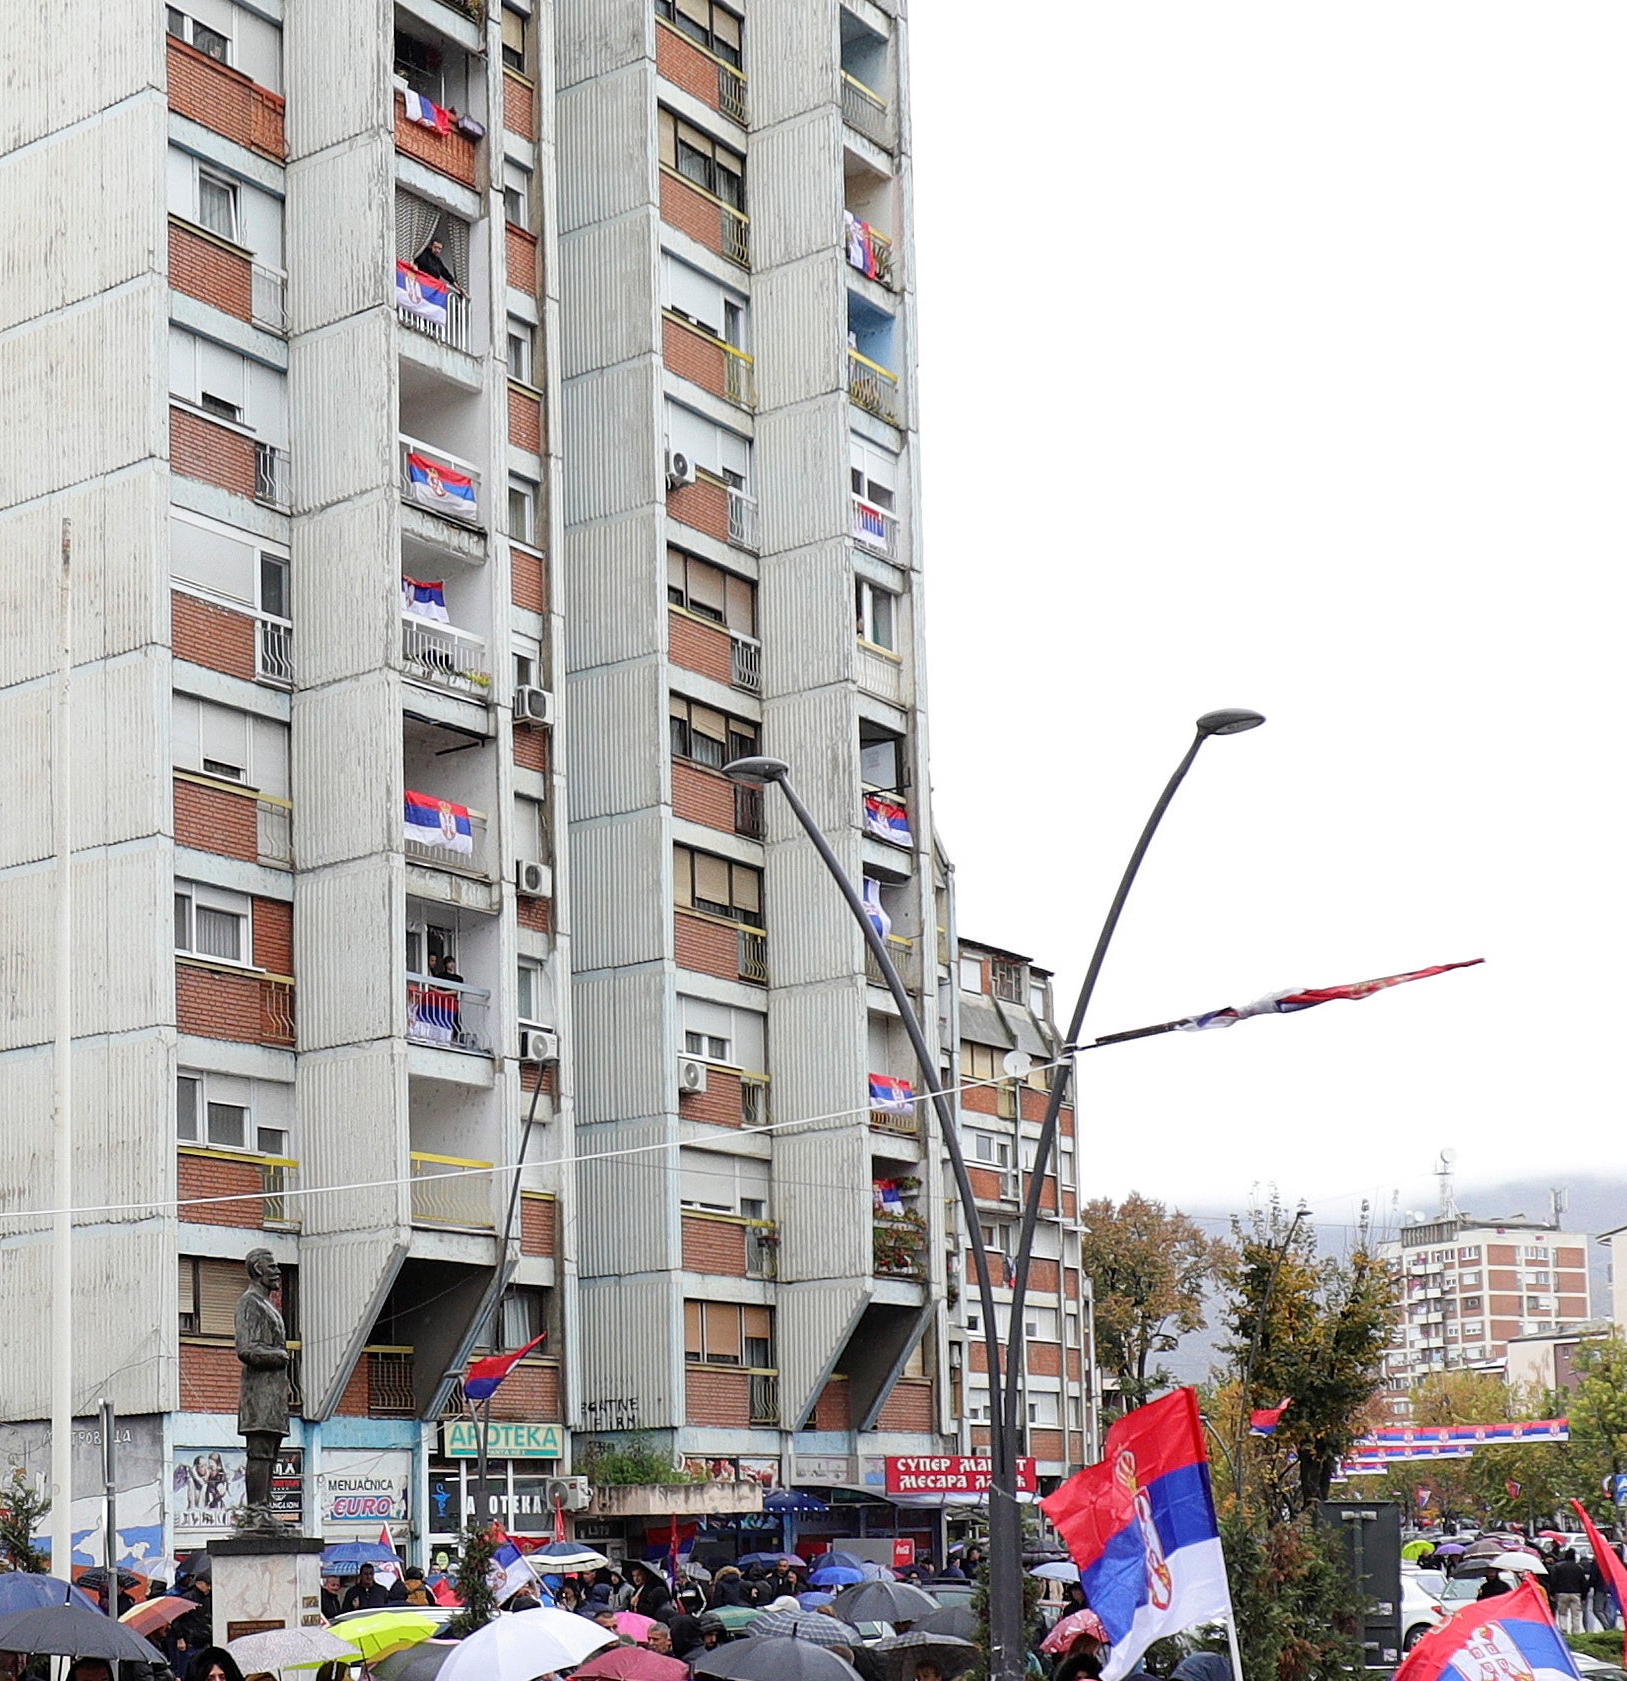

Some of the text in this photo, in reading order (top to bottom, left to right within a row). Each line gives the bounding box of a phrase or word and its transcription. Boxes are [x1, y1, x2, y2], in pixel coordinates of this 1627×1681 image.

[897, 1458, 951, 1472] СУПЕР
[329, 1477, 393, 1491] MENJAČNICA
[899, 1475, 967, 1491] МЕСАРА
[467, 1496, 542, 1514] AOTEKA
